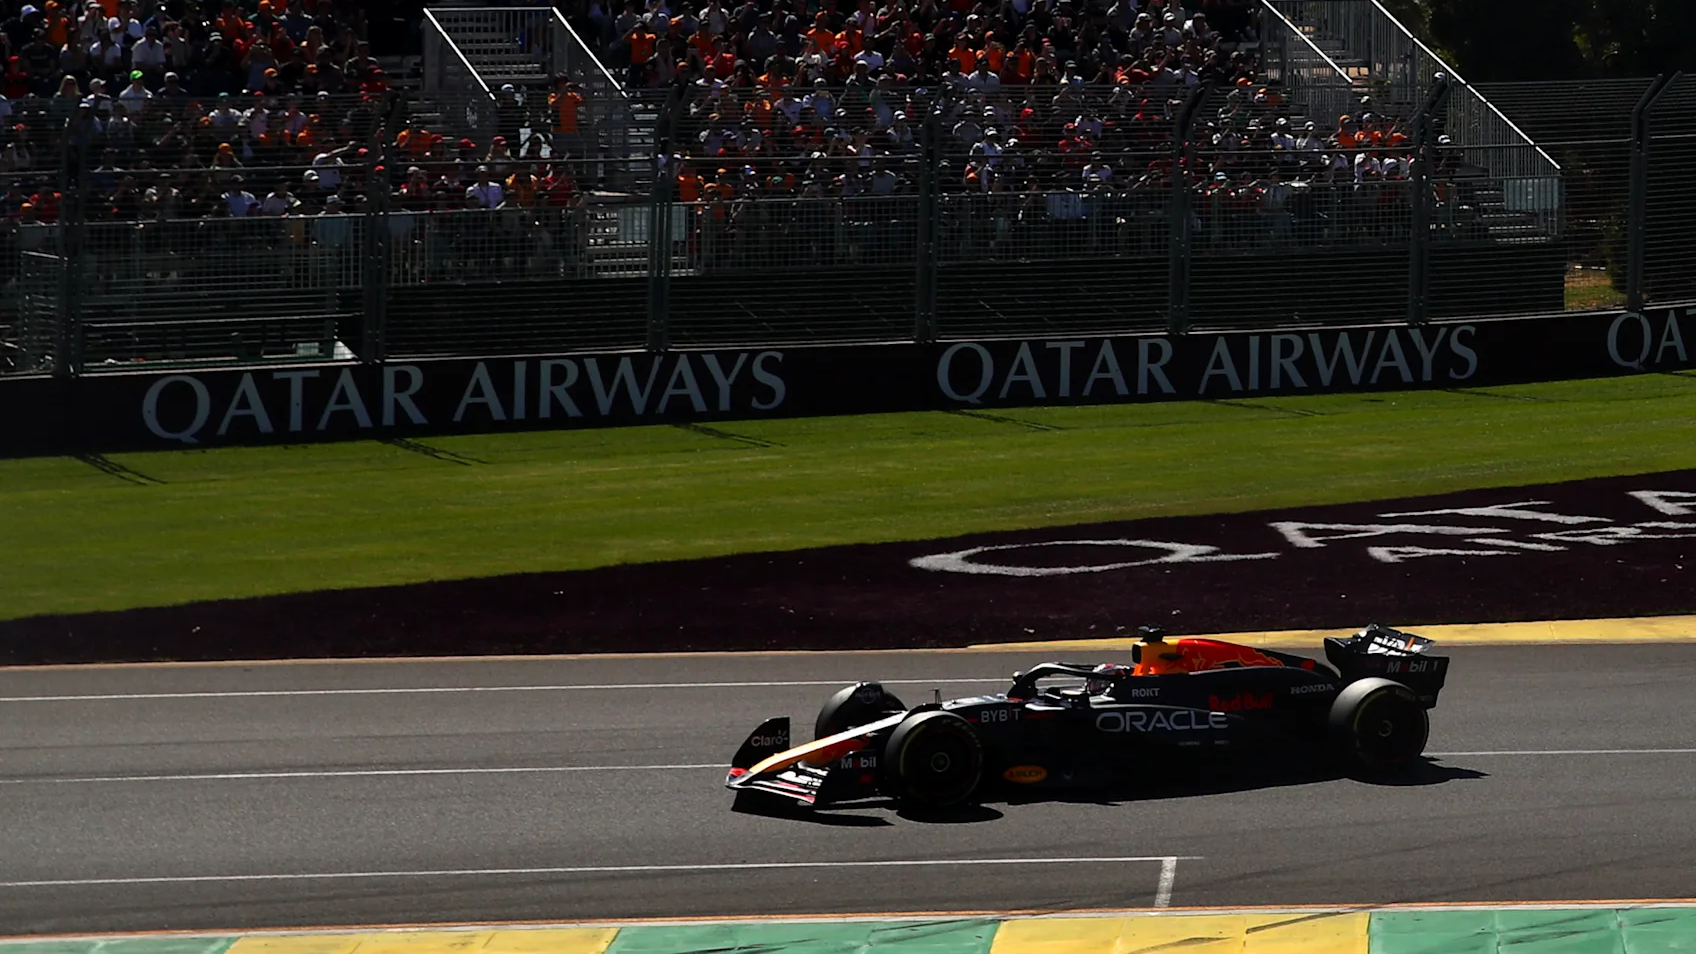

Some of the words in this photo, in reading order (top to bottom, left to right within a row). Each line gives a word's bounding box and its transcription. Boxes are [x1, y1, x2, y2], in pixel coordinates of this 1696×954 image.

[936, 337, 1177, 406] QATAR
[1199, 325, 1478, 395] AIRWAYS
[142, 364, 429, 444] QATAR
[452, 350, 788, 423] AIRWAYS
[1387, 660, 1428, 674] Mobil
[1290, 683, 1336, 695] HONDA
[1095, 710, 1229, 732] ORACLE
[751, 733, 786, 748] Claro
[840, 756, 877, 769] Mobil
